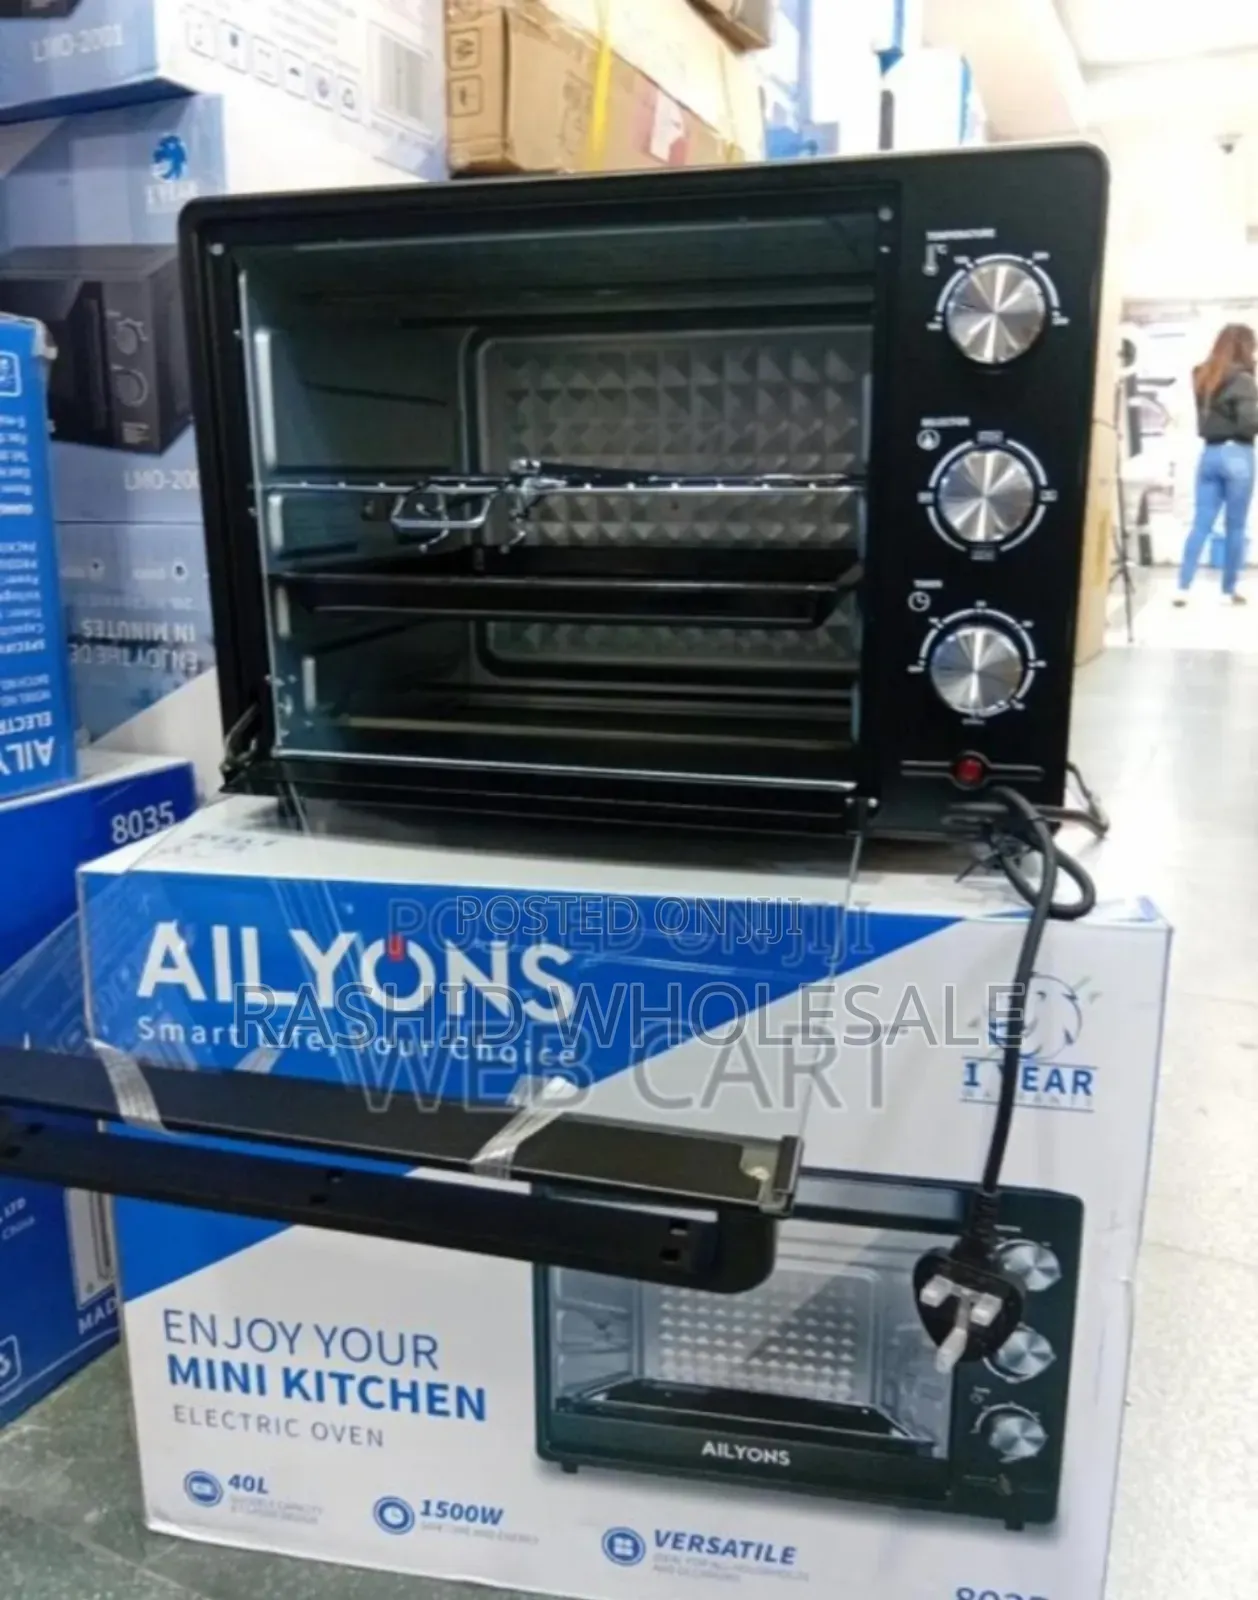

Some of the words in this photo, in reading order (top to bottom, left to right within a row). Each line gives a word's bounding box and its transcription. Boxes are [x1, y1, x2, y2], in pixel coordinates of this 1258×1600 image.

[81, 617, 168, 643] MINUTES
[110, 801, 175, 844] 8035
[137, 921, 577, 1023] AILYONS
[137, 1016, 241, 1046] Smart
[451, 1035, 577, 1067] Choice
[999, 1063, 1093, 1096] EAR
[163, 1308, 302, 1356] ENJOY
[312, 1323, 439, 1370] YOUR
[167, 1353, 267, 1397] MINI
[282, 1366, 487, 1422] KITCHEN
[173, 1403, 301, 1438] ELECTRIC
[310, 1421, 385, 1448] OVEN
[701, 1440, 792, 1467] AILYONS
[227, 1473, 270, 1495] 40L
[419, 1498, 504, 1526] 1500W
[653, 1528, 798, 1566] VERSATILE
